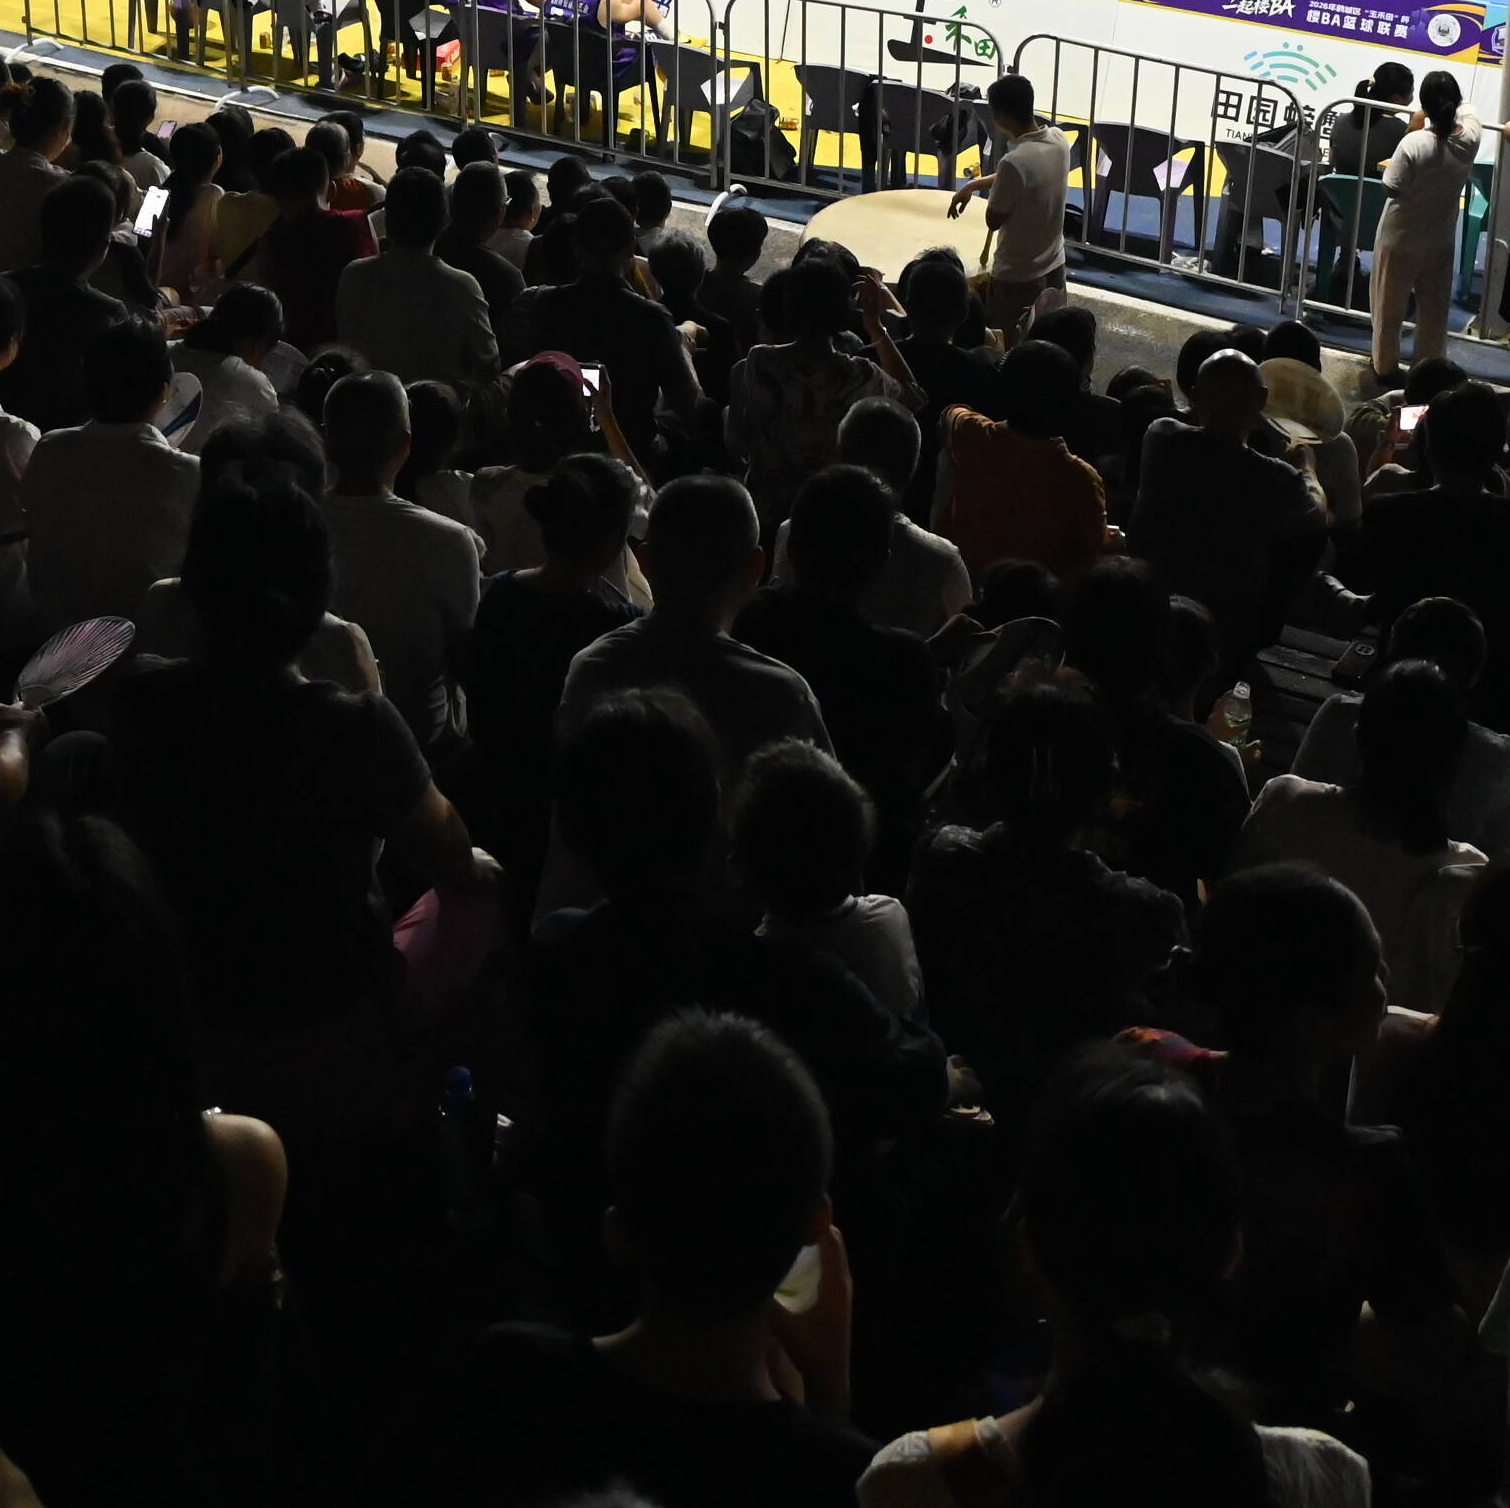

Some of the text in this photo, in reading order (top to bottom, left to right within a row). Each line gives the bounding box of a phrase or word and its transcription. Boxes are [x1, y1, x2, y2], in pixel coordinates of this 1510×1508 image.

[1307, 10, 1409, 39] 楼BA篮球联赛
